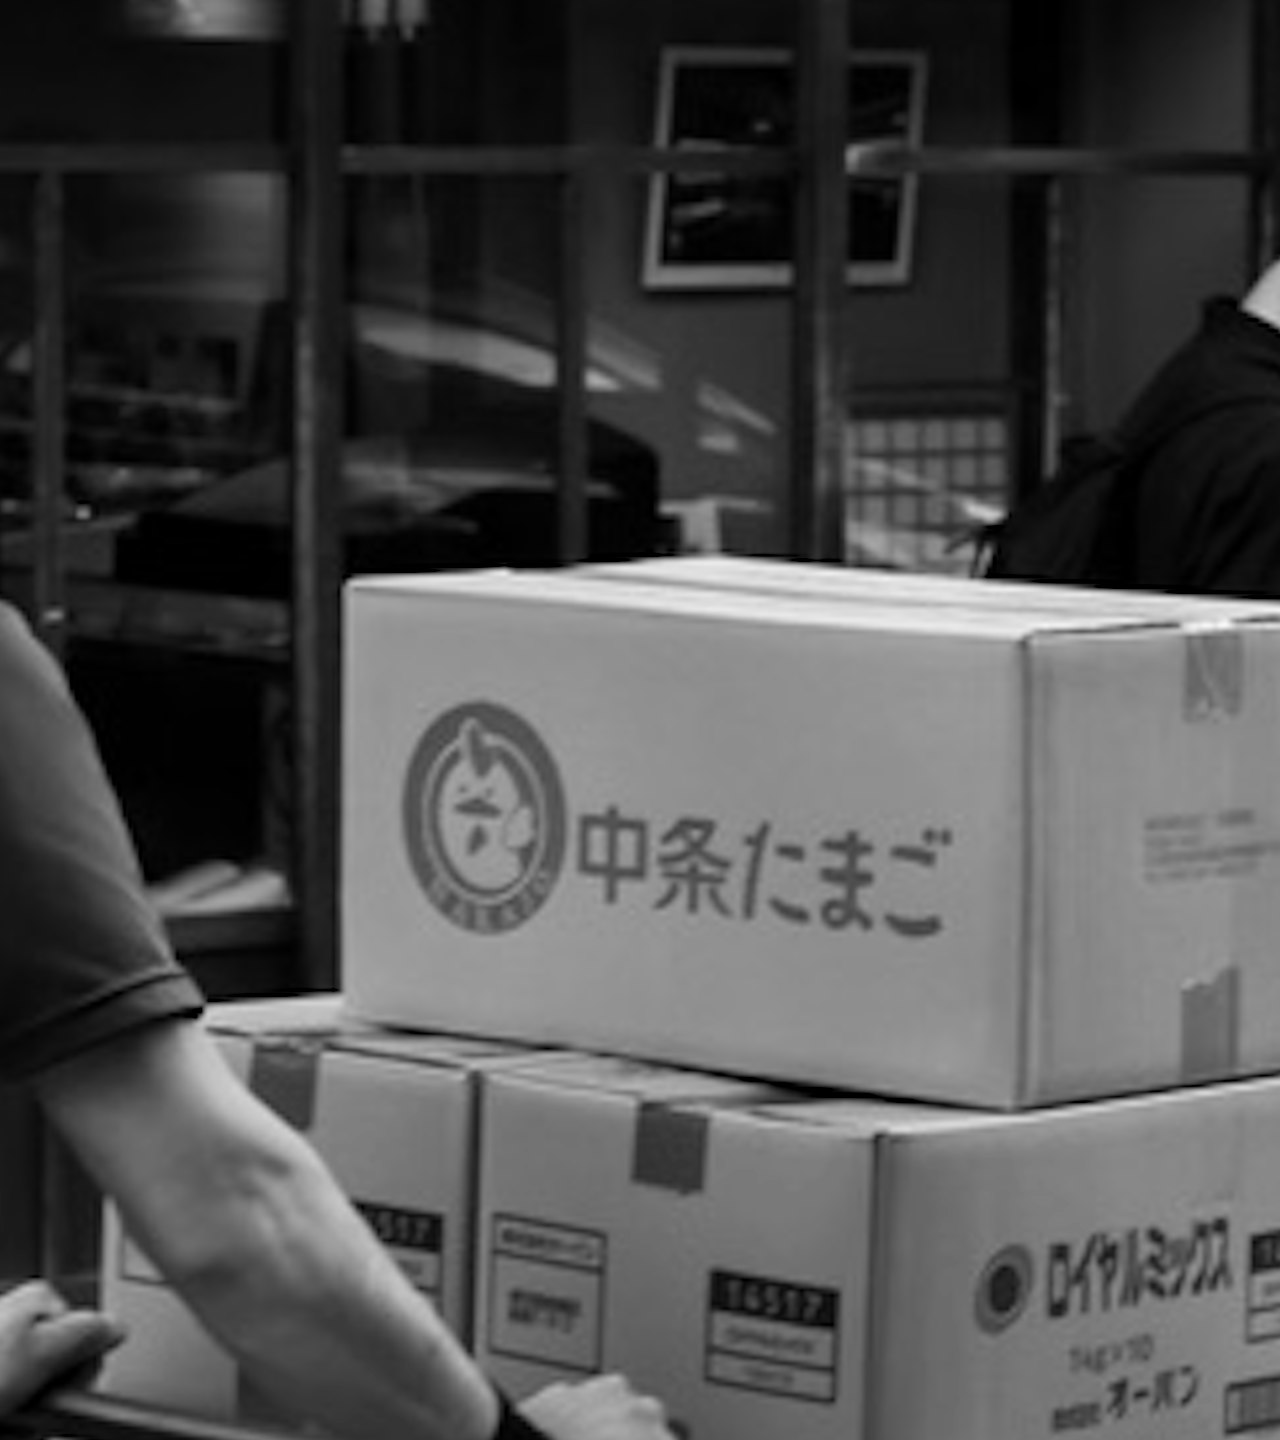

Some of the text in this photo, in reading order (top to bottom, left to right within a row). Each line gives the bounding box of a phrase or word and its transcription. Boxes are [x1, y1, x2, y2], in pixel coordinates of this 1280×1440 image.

[576, 803, 953, 937] 中条たまご
[1045, 1216, 1233, 1318] ロイヤルミックス
